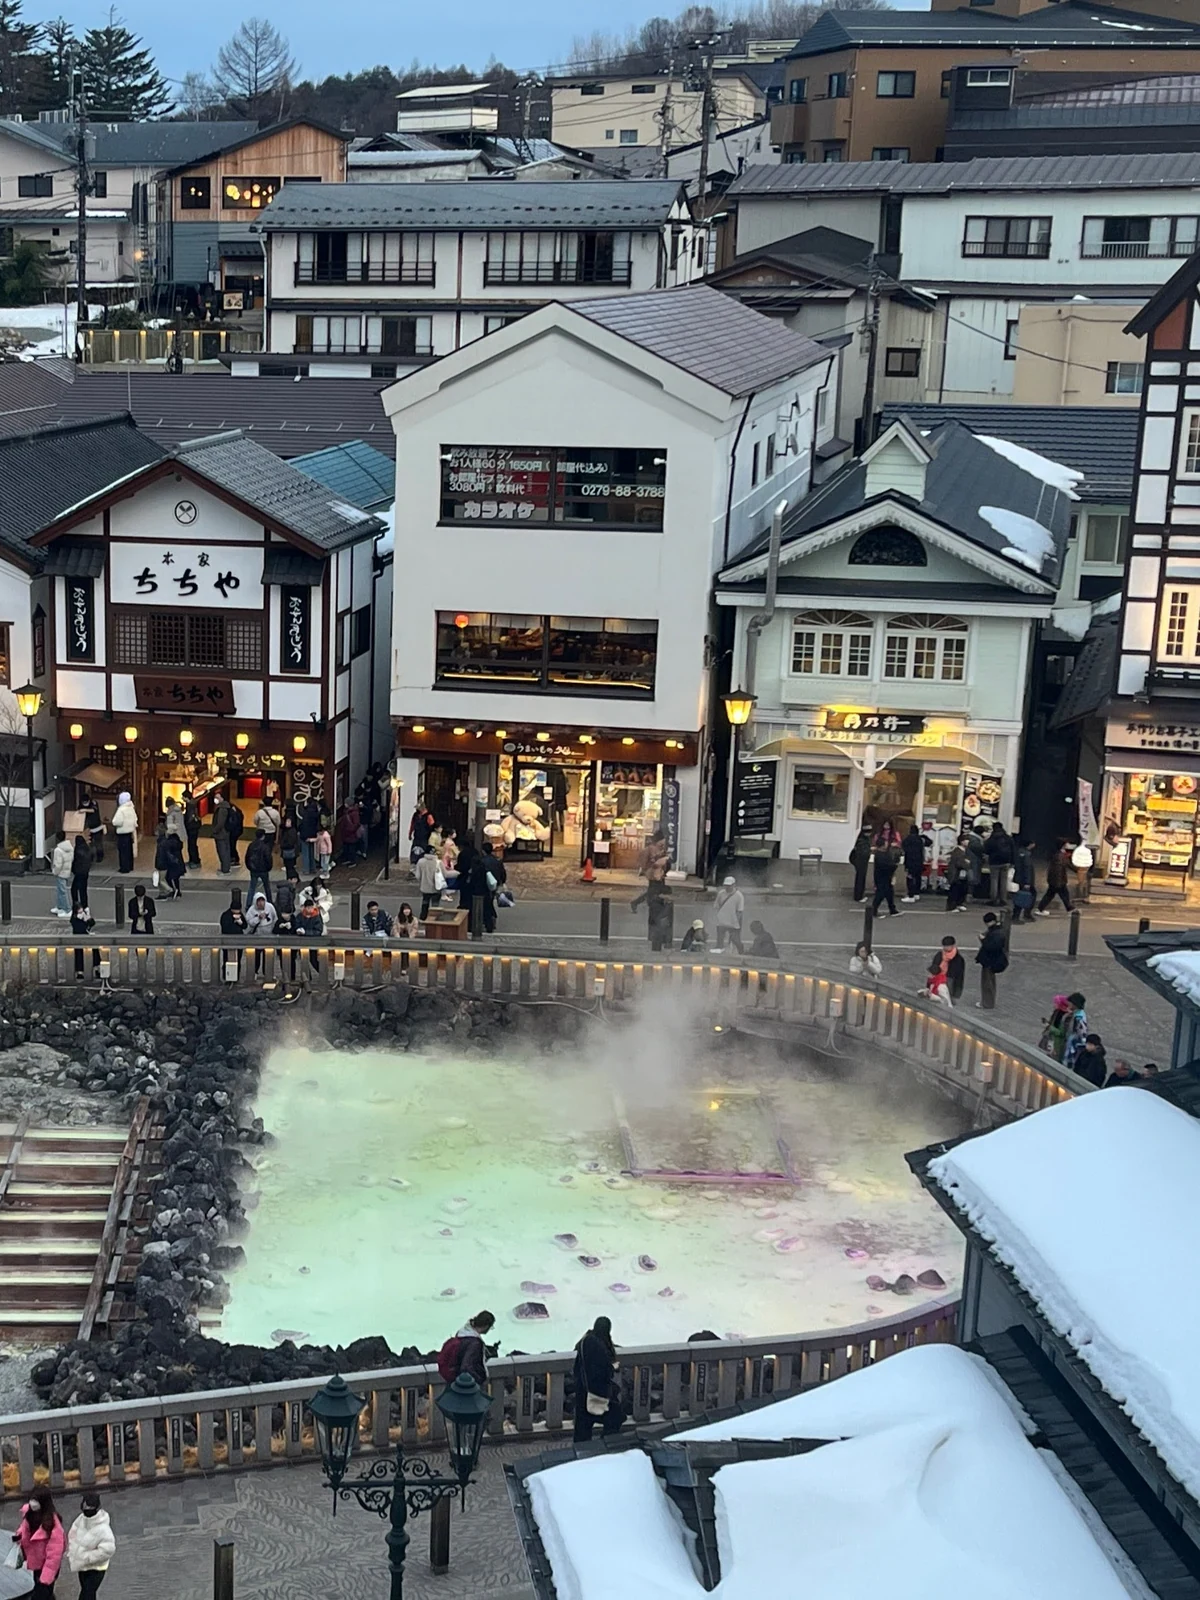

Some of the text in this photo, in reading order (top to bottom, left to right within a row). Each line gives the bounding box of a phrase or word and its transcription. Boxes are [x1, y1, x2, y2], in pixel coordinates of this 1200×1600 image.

[509, 460, 543, 471] 1650円
[449, 481, 485, 493] 3080円
[581, 484, 666, 498] 0279-88-3788
[463, 500, 535, 519] カラオケ
[162, 551, 211, 567] 本家
[133, 567, 241, 598] ちちや
[167, 683, 225, 705] ちちや
